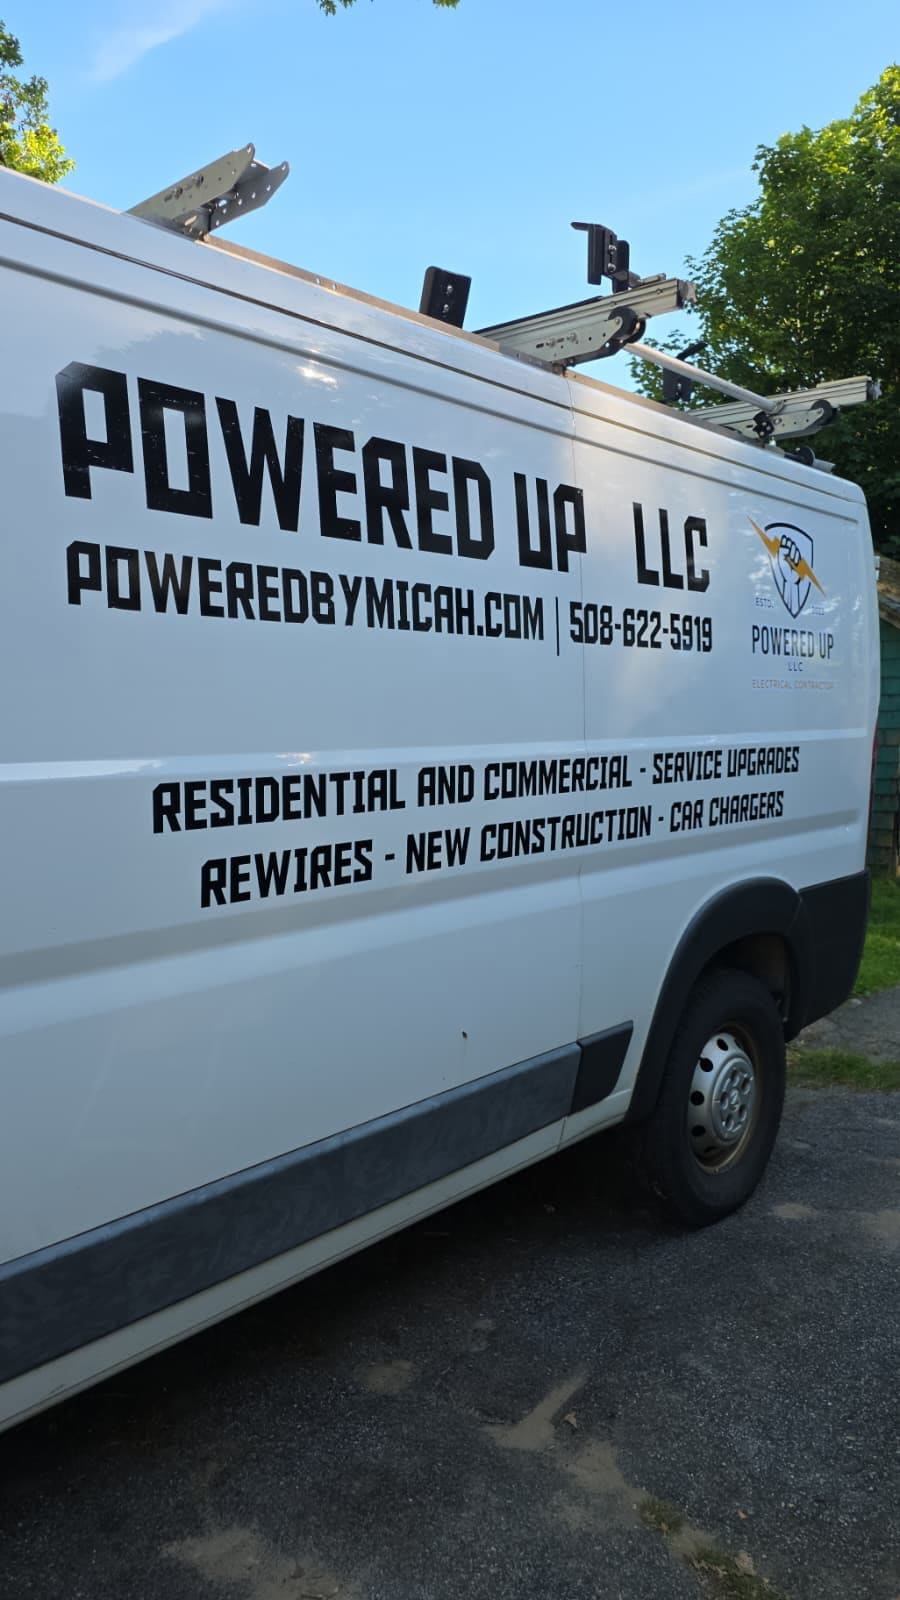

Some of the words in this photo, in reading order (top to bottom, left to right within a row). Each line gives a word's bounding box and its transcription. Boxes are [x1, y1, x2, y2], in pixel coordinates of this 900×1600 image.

[55, 361, 495, 561] POWERED
[513, 471, 587, 573] UP
[632, 501, 710, 593] LLC
[66, 540, 544, 641] POWEREDBYMICAH.COM
[569, 600, 713, 653] 508-622-5919
[752, 624, 814, 658] POWERED
[819, 633, 834, 659] UP
[788, 661, 803, 672] LLC
[152, 768, 406, 834] RESIDENTIAL
[417, 763, 475, 808] AND
[483, 755, 633, 801] COMMERCIAL
[652, 749, 723, 785] SERVICE
[727, 746, 801, 778] UPGRADES
[200, 838, 373, 909] REWIRES
[406, 826, 471, 875] NEW
[480, 804, 652, 863] CONSTRUCTION
[670, 799, 704, 833] CAR
[708, 790, 785, 827] CHARGERS
